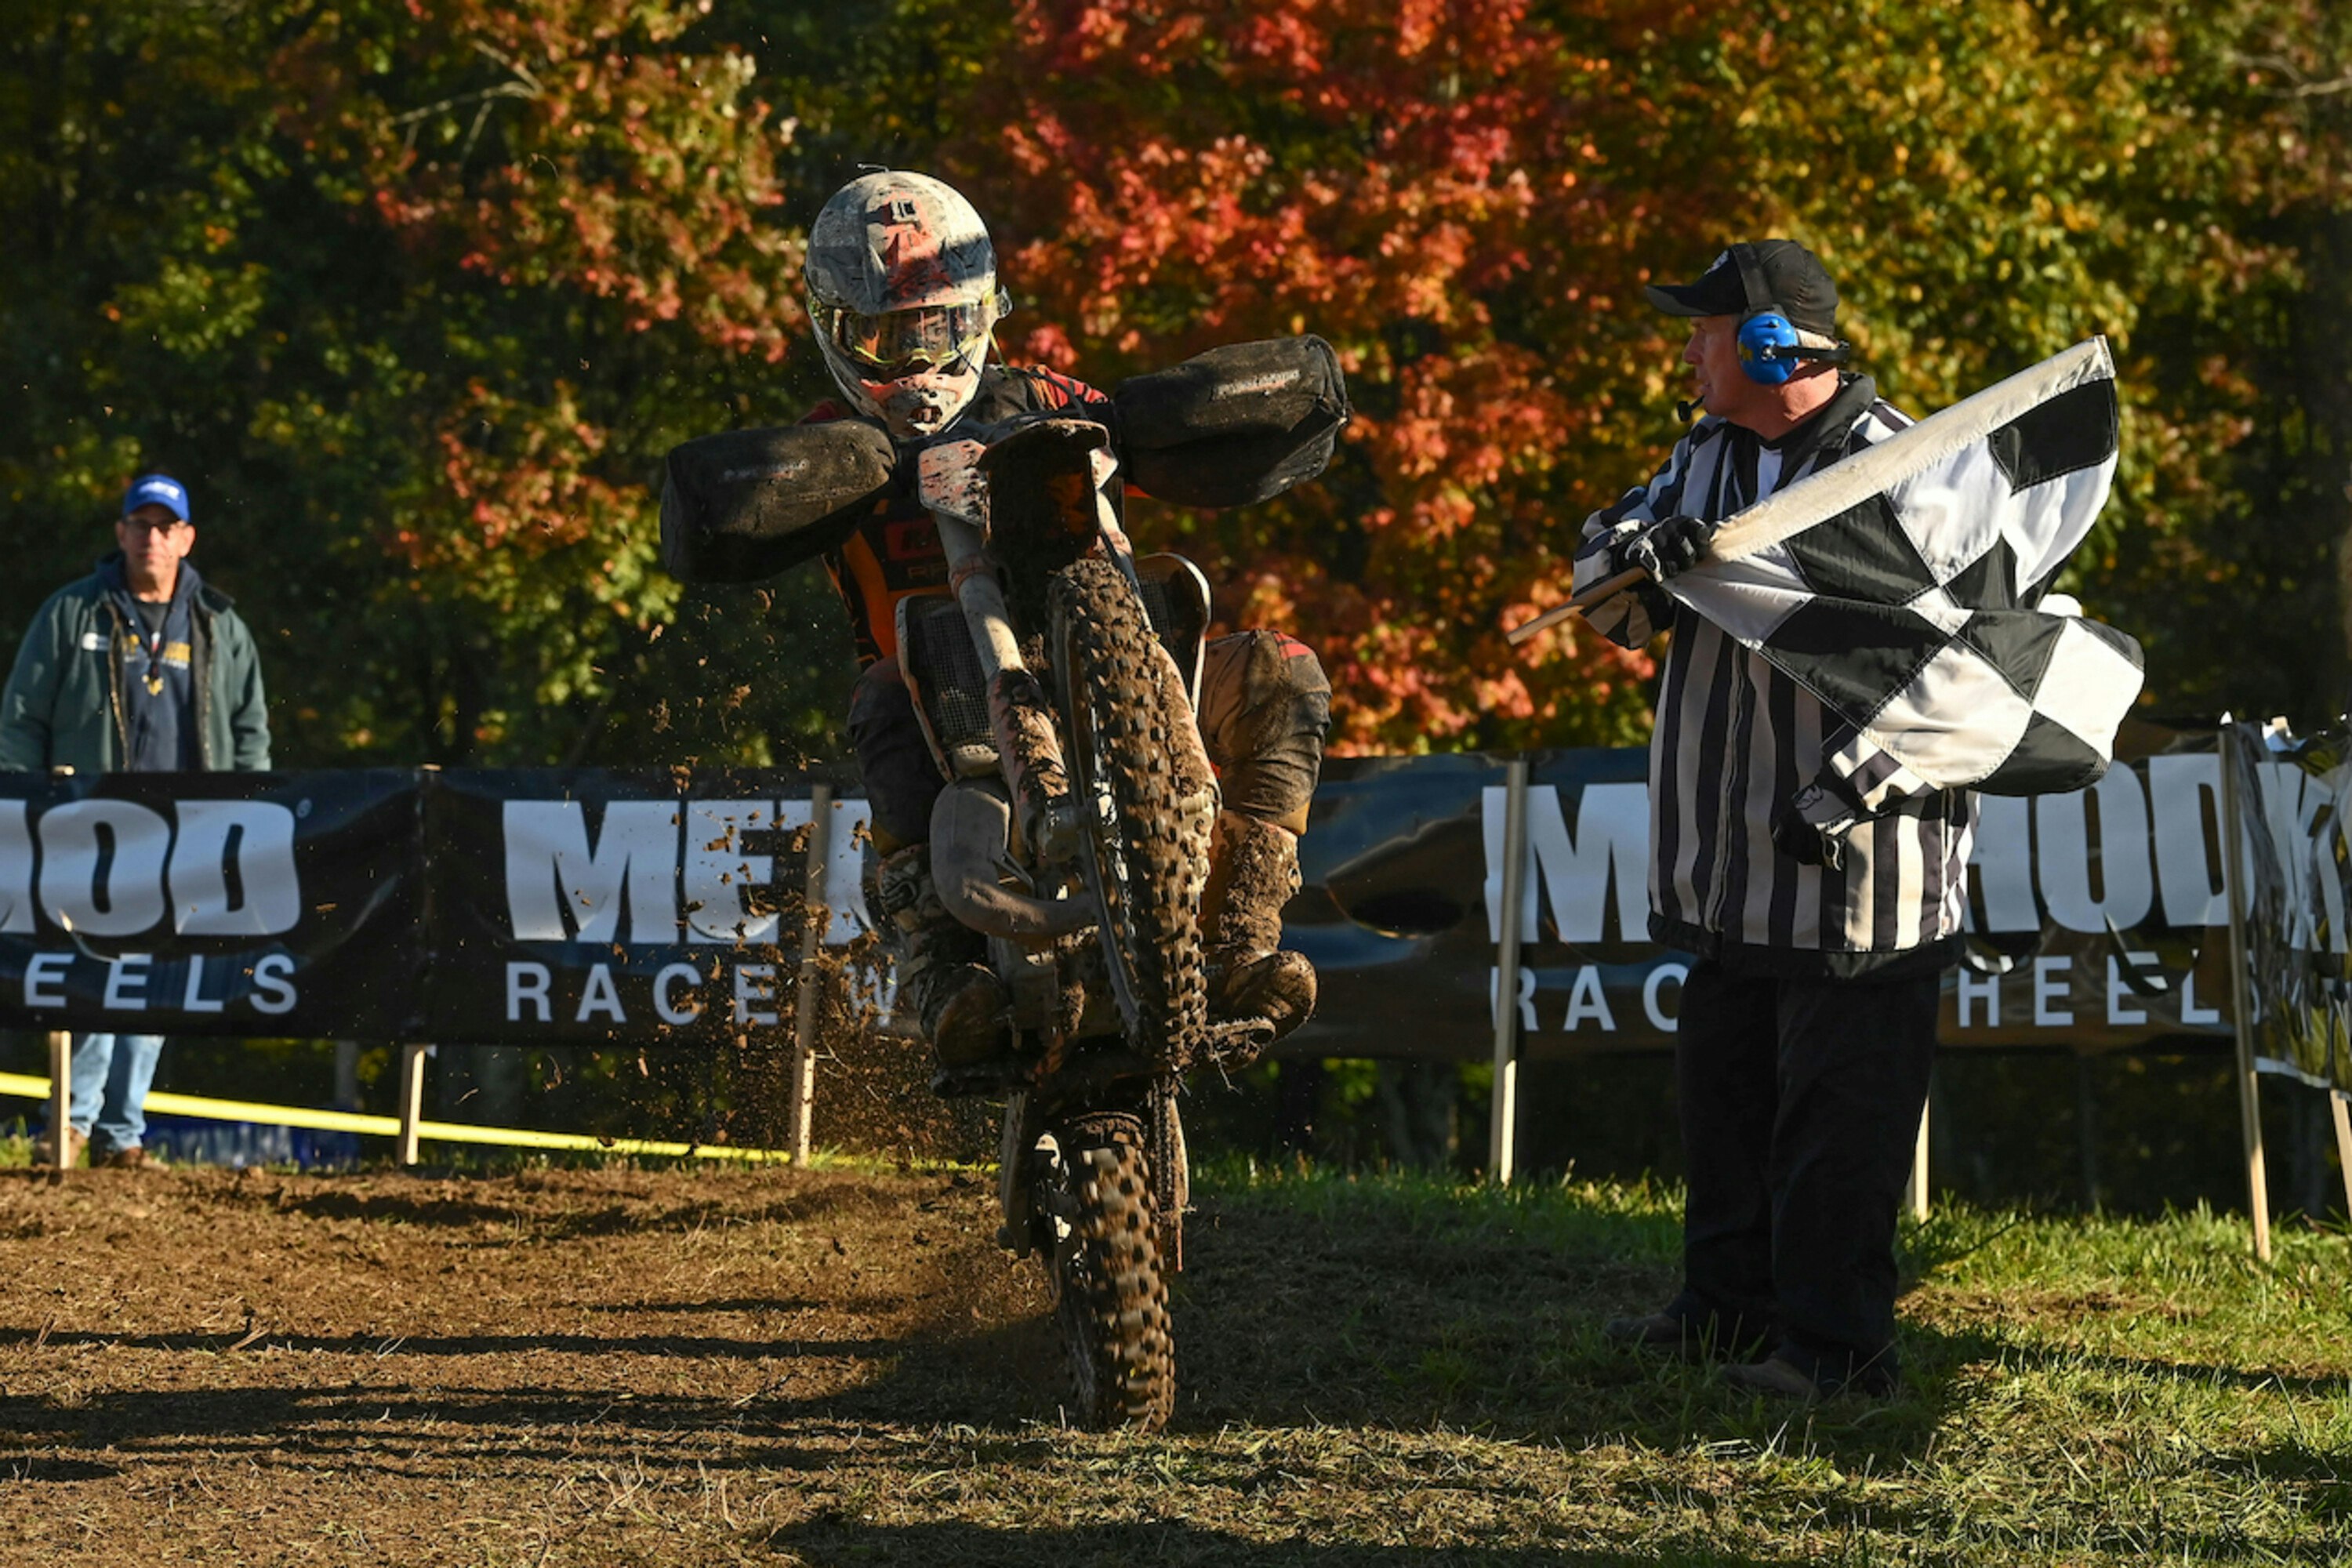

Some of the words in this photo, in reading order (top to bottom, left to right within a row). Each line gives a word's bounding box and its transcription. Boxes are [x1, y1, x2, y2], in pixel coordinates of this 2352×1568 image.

[0, 799, 301, 936] OD
[506, 961, 779, 1025] RACE
[1958, 949, 2260, 1028] HEEL
